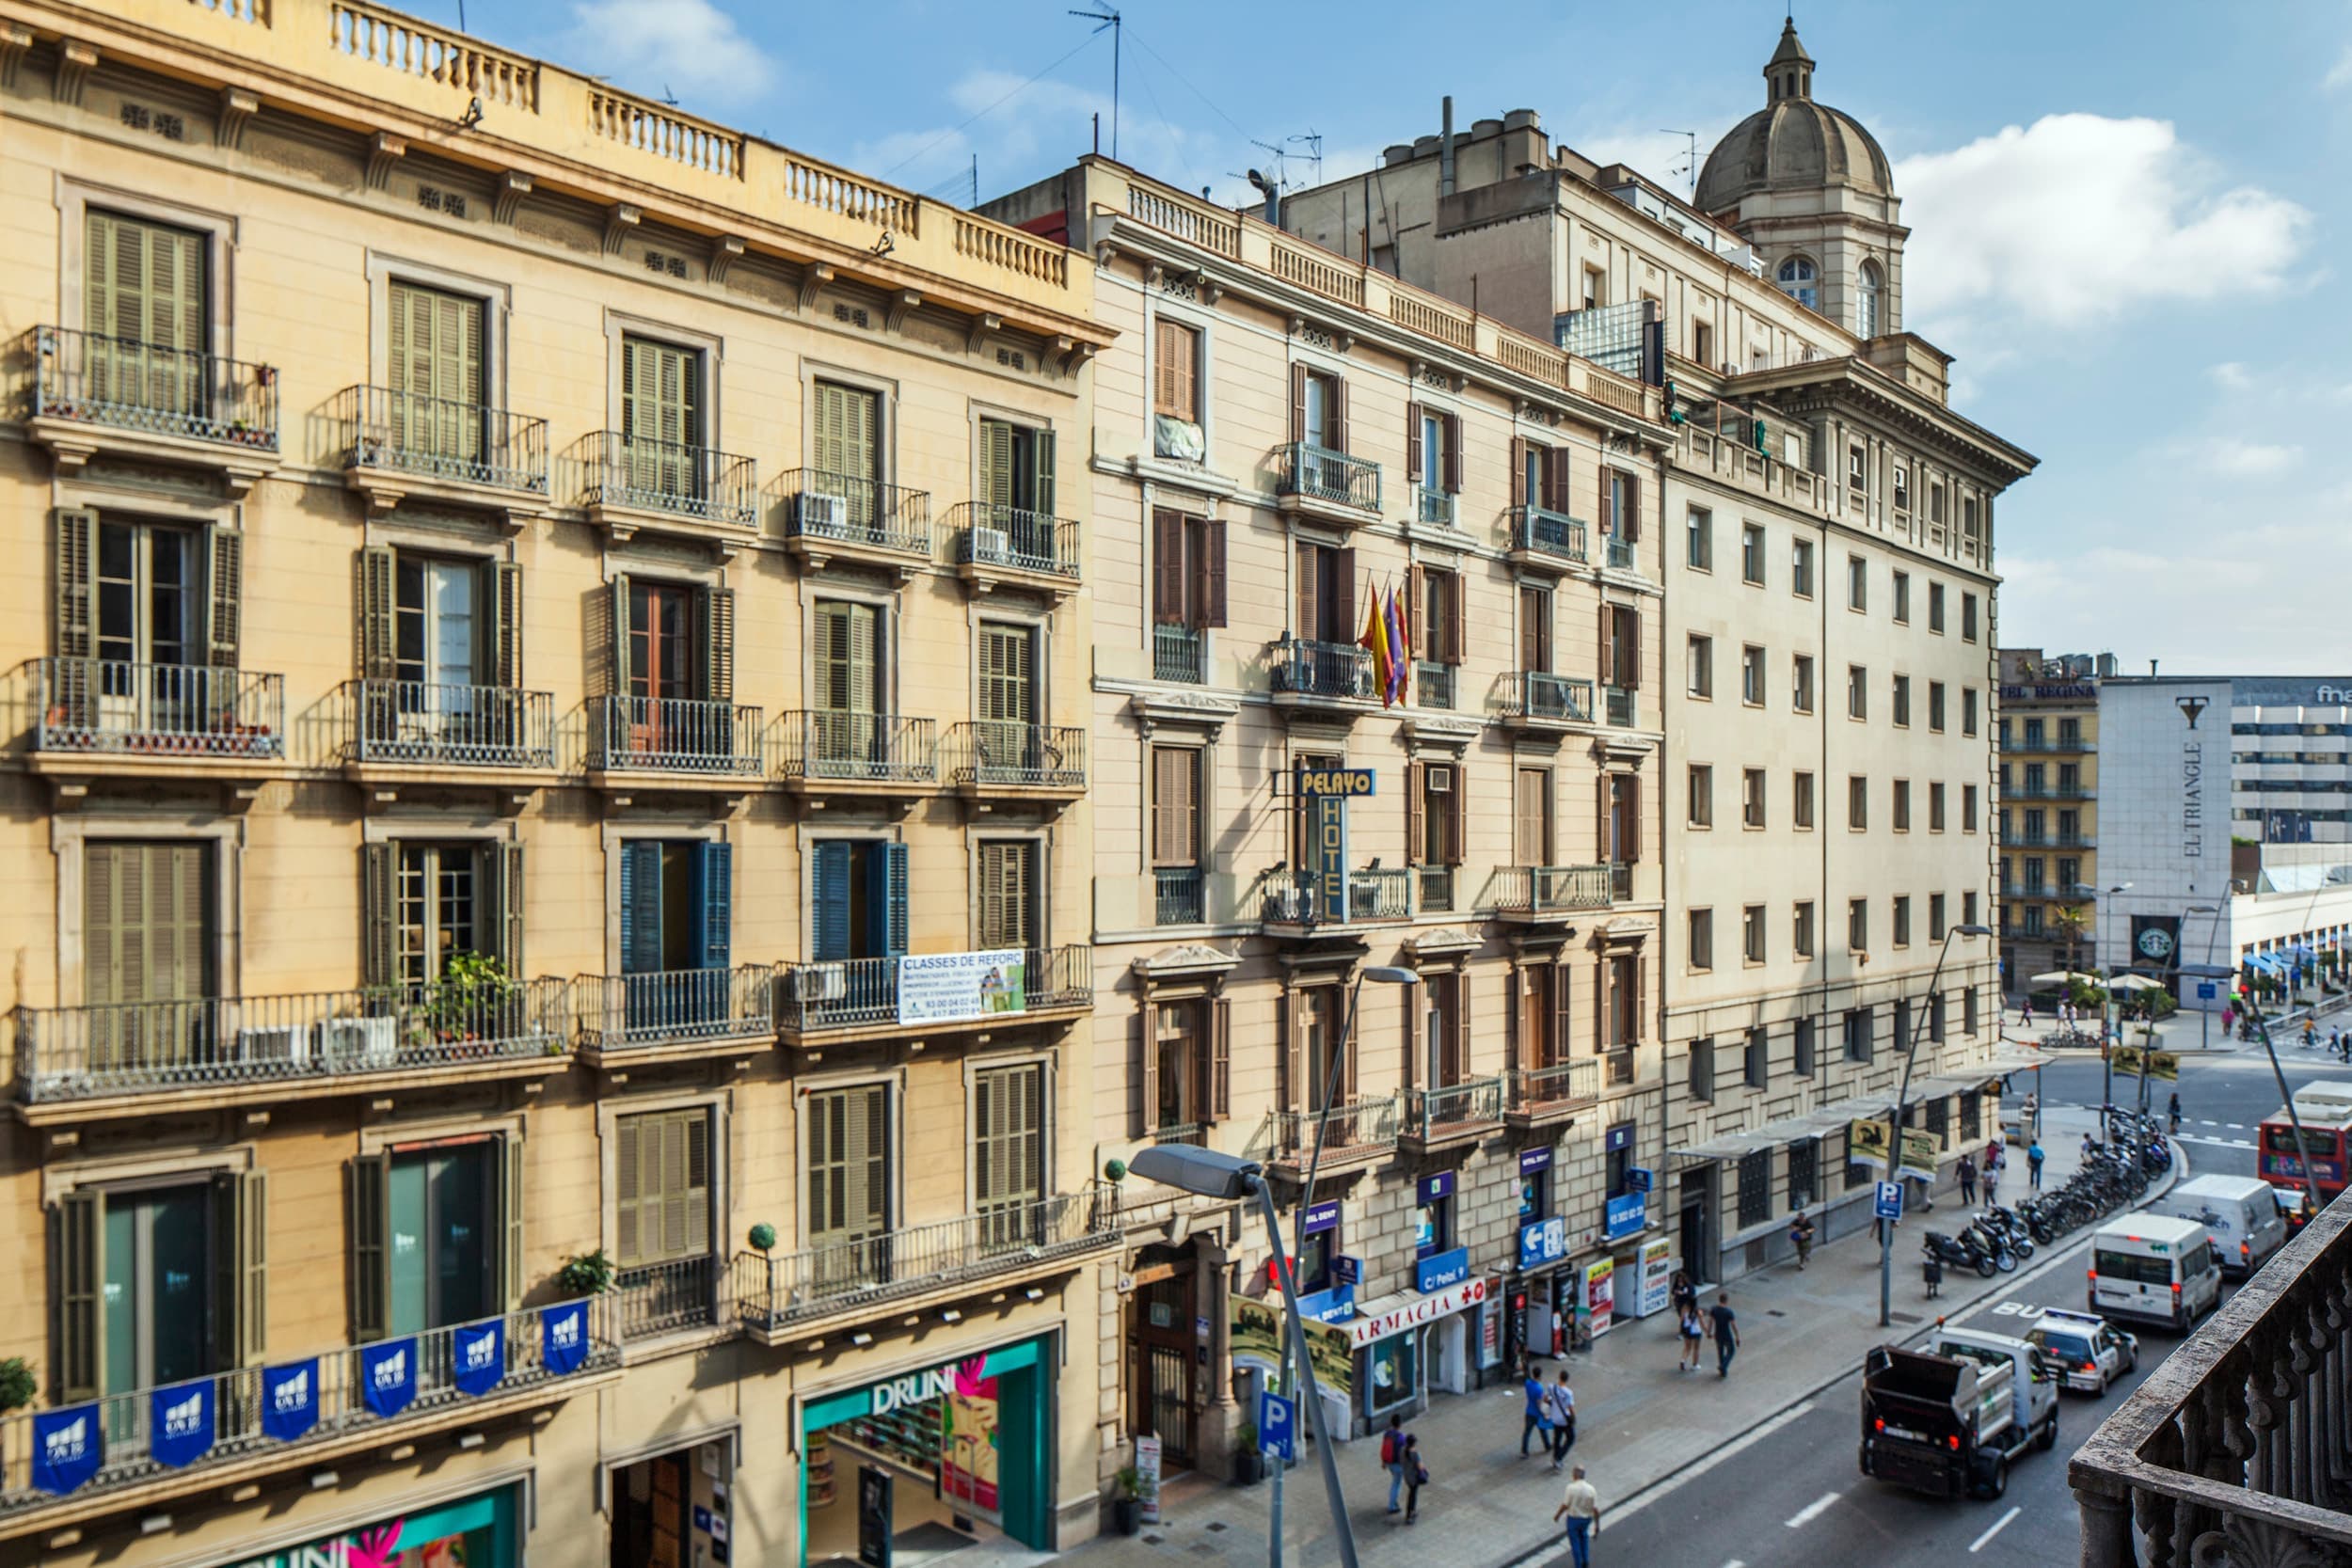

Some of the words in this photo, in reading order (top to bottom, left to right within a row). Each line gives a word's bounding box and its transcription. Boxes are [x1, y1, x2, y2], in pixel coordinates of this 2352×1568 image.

[2035, 685, 2096, 698] REGINA
[2317, 685, 2352, 704] fna
[1302, 771, 1371, 794] PELAYO
[2184, 742, 2201, 832] TRIANGLE
[1323, 800, 1341, 920] HOTEL
[903, 957, 958, 971] CLASSES
[960, 955, 976, 968] DE
[1882, 1182, 1899, 1202] P
[1992, 1301, 2046, 1319] BU
[871, 1364, 958, 1416] DRUNI
[1265, 1398, 1287, 1431] P
